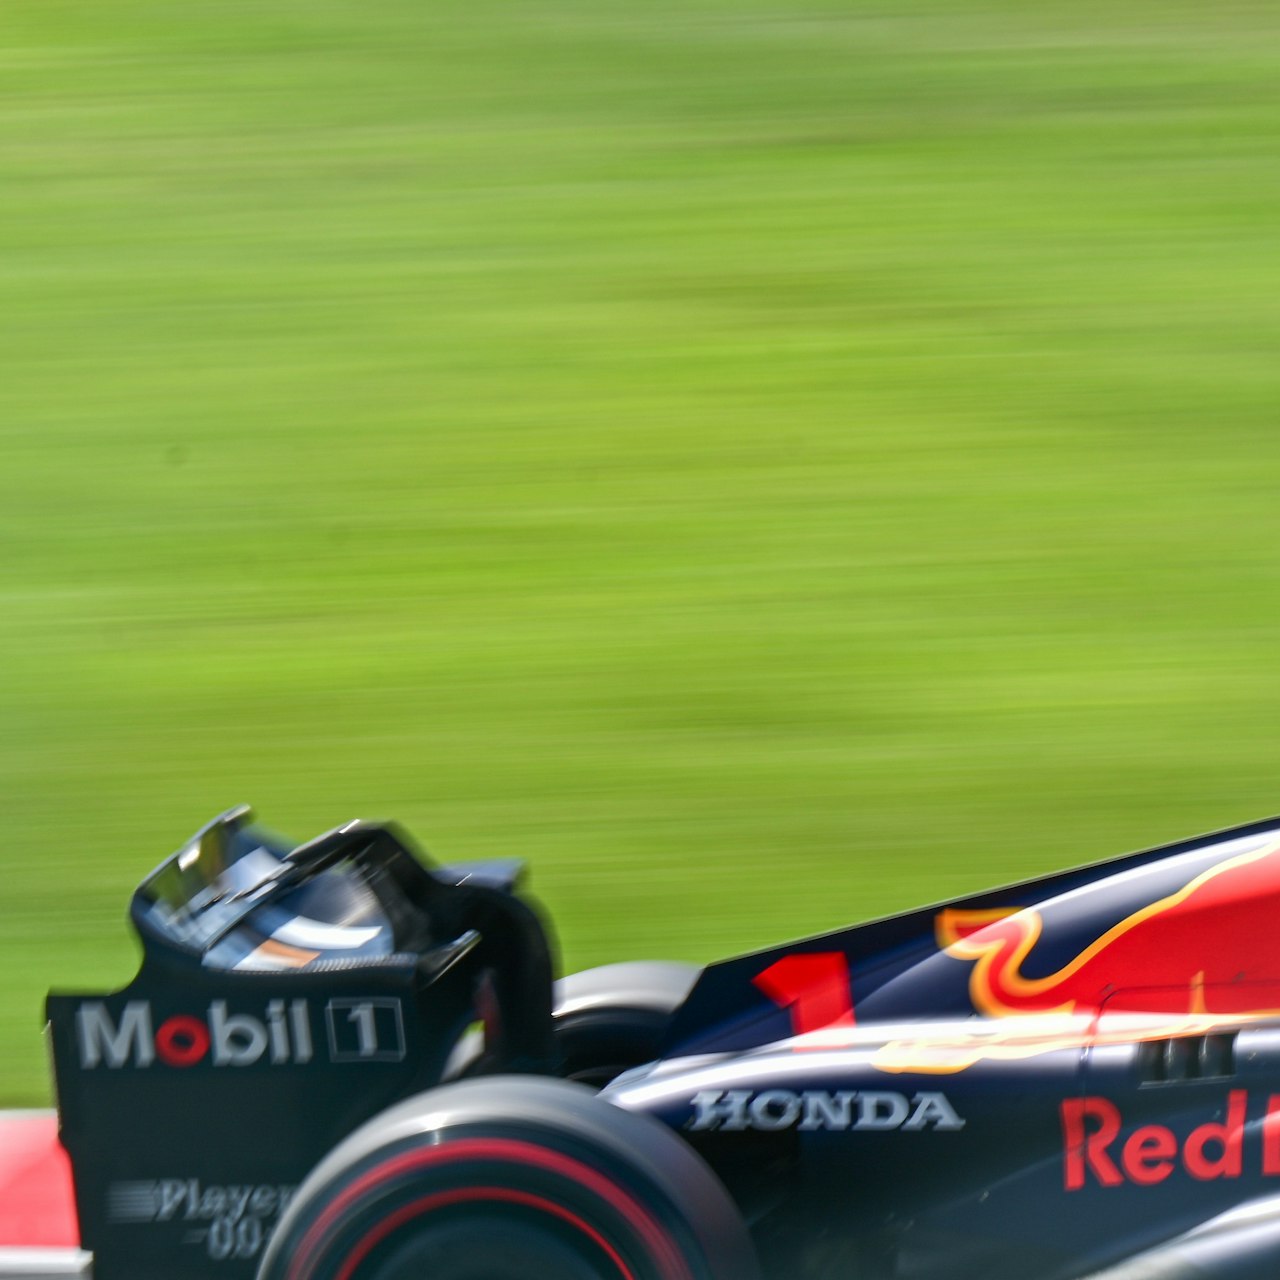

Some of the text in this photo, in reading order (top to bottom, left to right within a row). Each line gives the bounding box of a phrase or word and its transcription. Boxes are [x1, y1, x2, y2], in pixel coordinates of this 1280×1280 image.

[77, 1000, 314, 1068] Mobil
[750, 951, 857, 1053] 1
[687, 1091, 966, 1132] HONDA
[1060, 1089, 1248, 1192] Red
